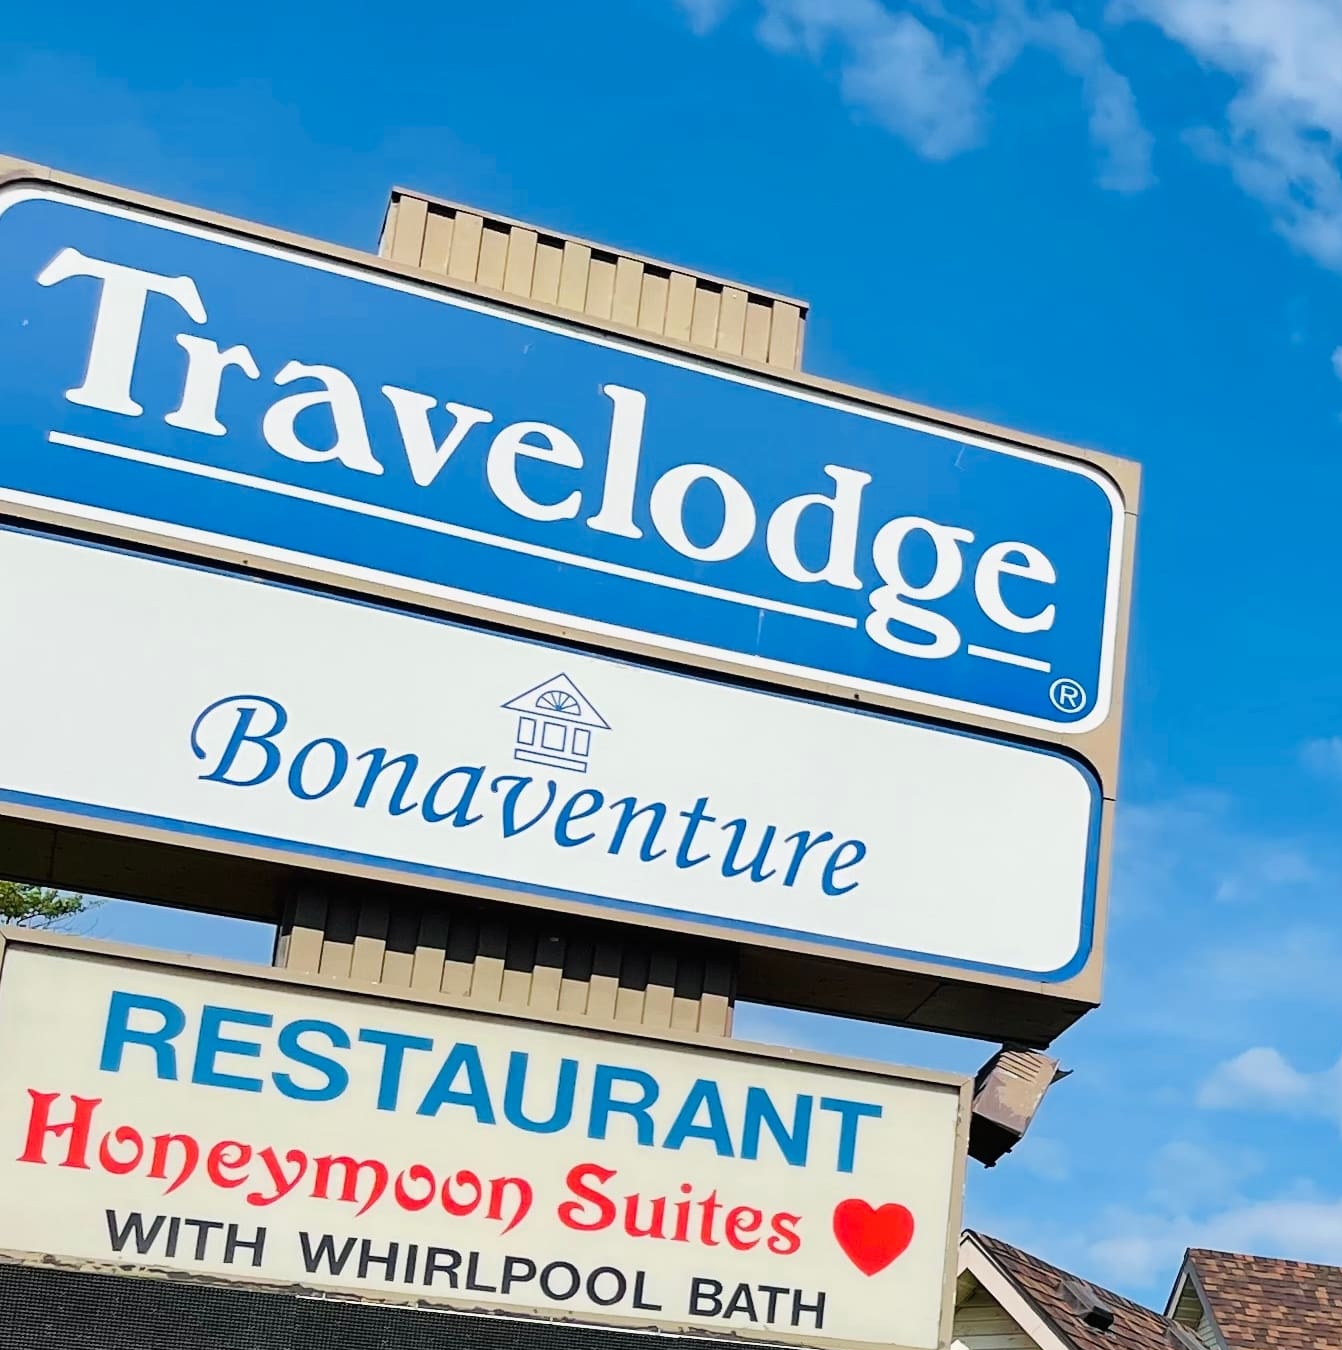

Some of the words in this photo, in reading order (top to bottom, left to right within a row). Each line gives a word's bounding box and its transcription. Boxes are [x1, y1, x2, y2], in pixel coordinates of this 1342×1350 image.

[36, 247, 1057, 659] Travelodge
[190, 694, 868, 898] Bonaventure
[17, 1088, 535, 1232] Honeymoon
[557, 1162, 803, 1257] Suites
[99, 990, 883, 1174] RESTAURANT
[104, 1209, 267, 1268] WITH
[298, 1230, 663, 1313] WHIRLPOOL
[688, 1277, 827, 1331] BATH
